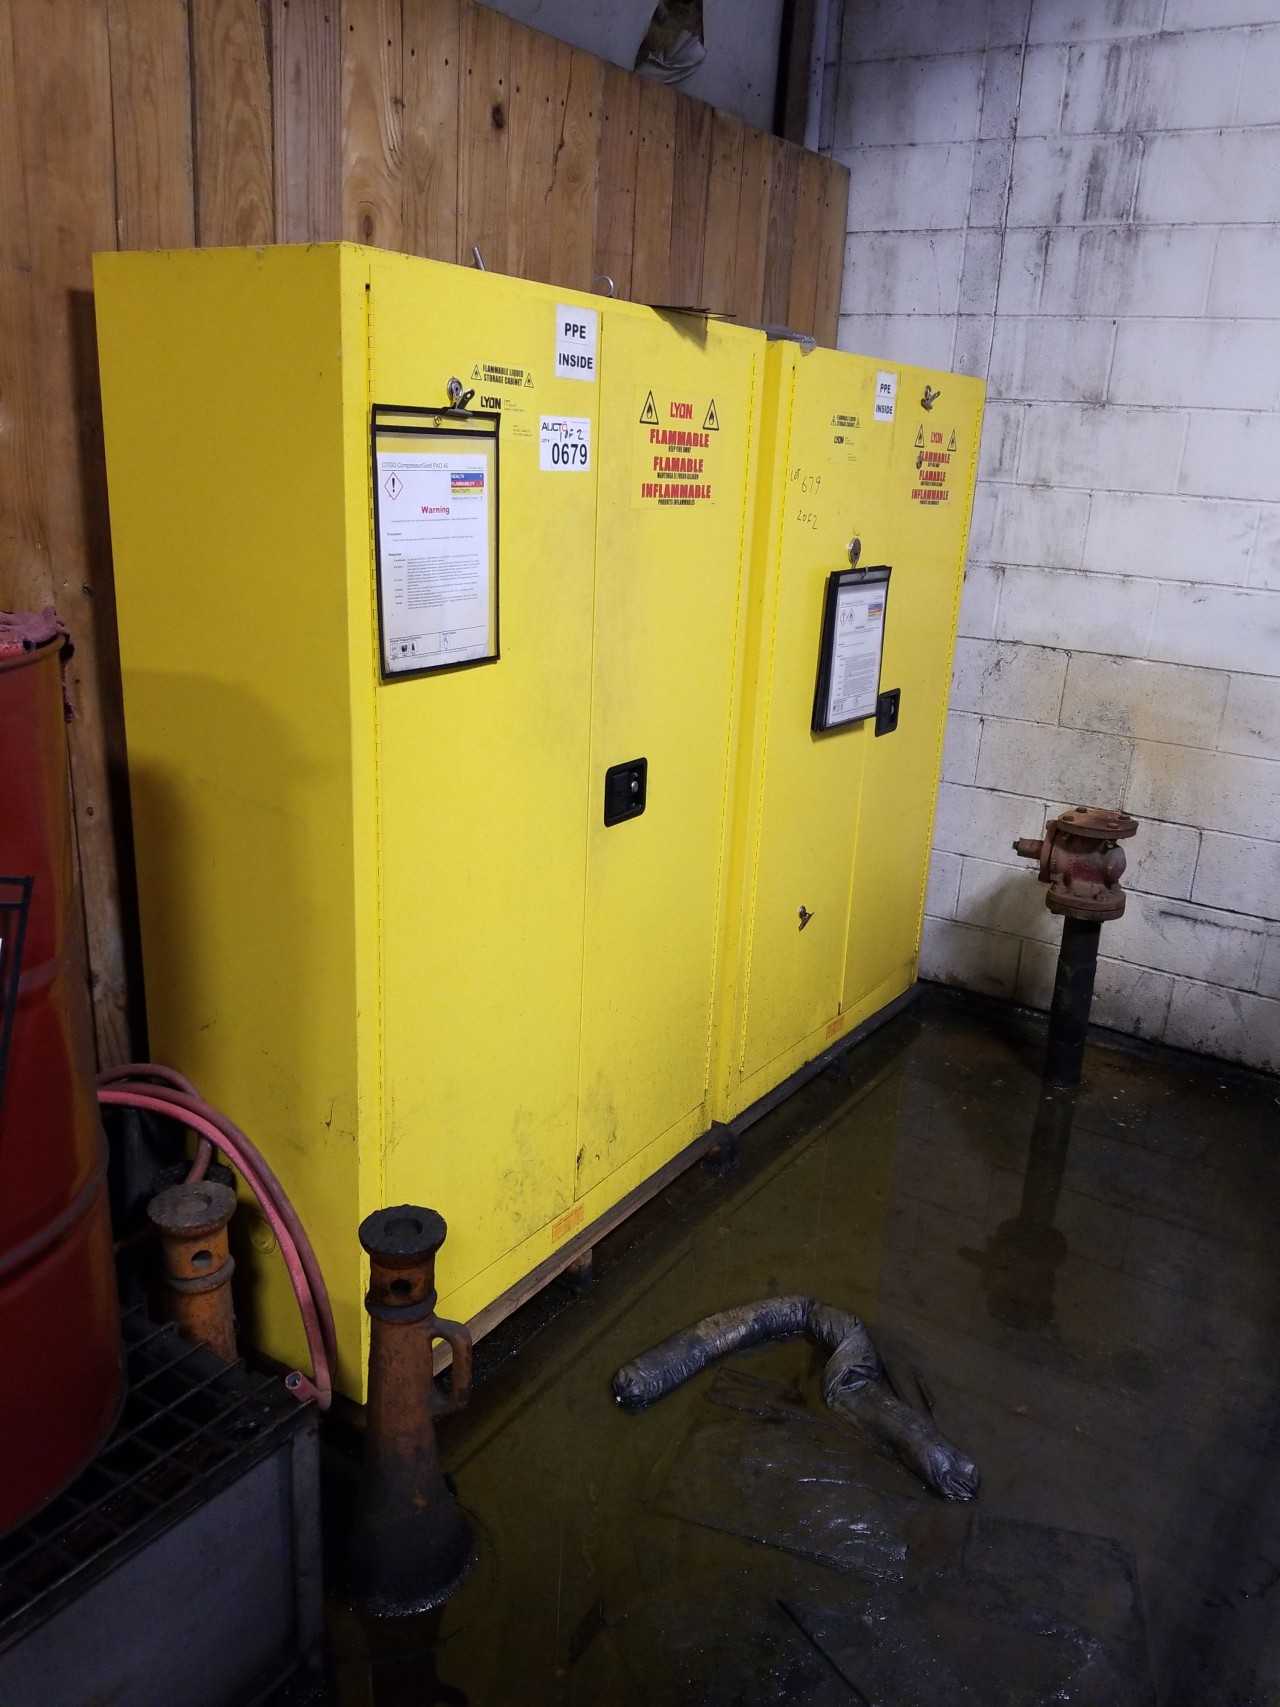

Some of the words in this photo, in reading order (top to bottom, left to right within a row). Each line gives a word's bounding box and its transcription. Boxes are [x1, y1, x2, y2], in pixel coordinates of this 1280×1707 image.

[564, 322, 586, 339] PPE
[558, 352, 593, 370] INSIDE
[880, 383, 891, 394] PPE
[480, 395, 501, 410] LYON
[670, 402, 693, 419] LYON
[876, 404, 893, 415] INSIDE
[650, 428, 710, 448] FLAMMABLE
[551, 443, 588, 465] 0679
[653, 456, 704, 474] FLAMABLE
[641, 483, 712, 499] INFLAMMABLE
[421, 505, 450, 515] Warning
